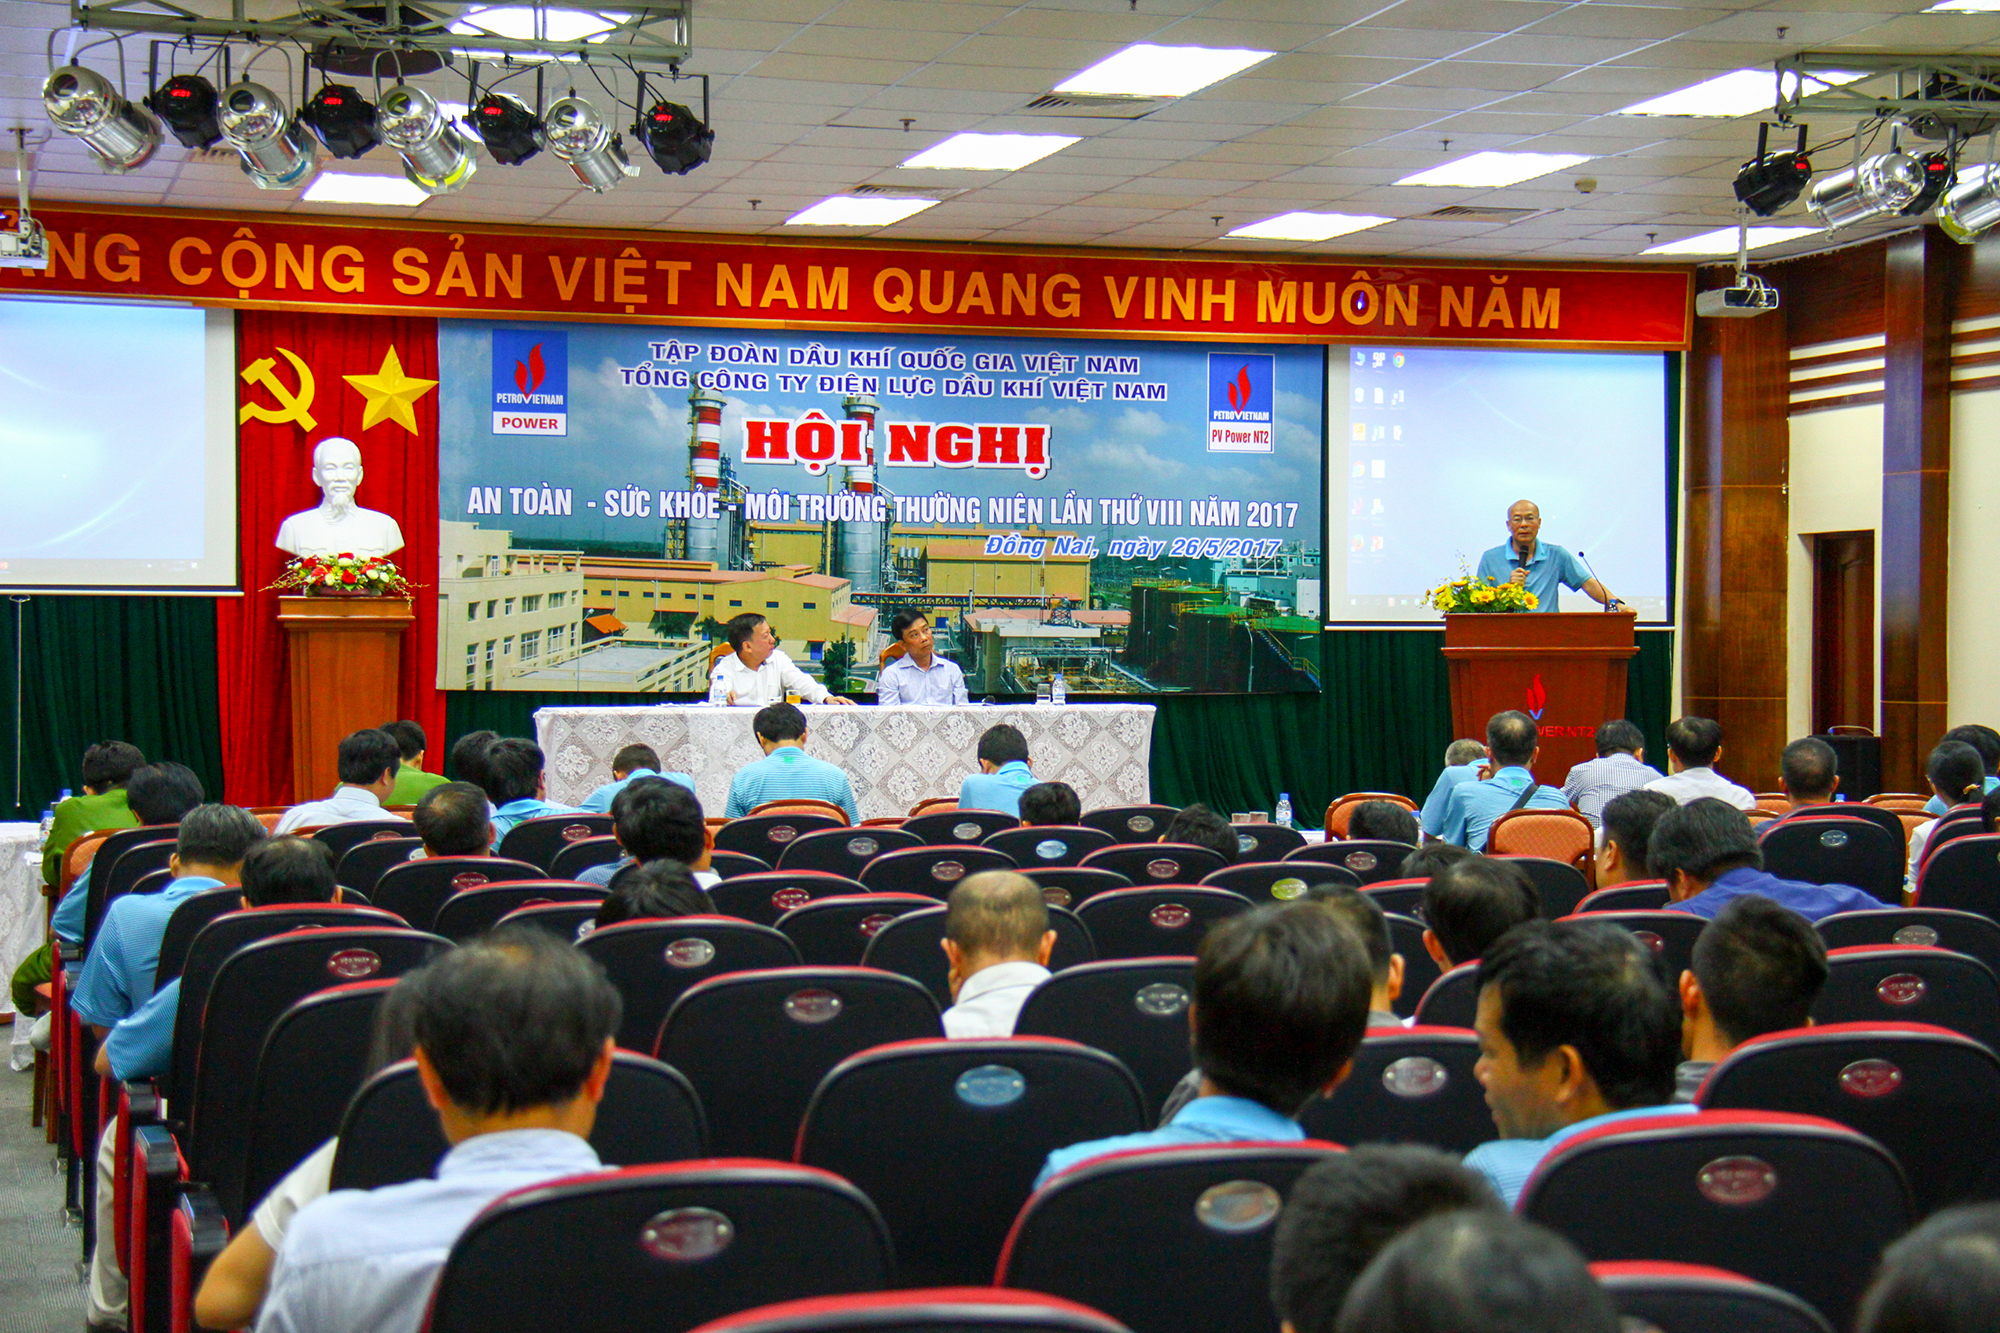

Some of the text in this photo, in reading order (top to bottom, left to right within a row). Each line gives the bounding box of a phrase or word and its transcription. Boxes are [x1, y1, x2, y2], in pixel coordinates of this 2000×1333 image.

[168, 227, 366, 299] CỘNG
[392, 233, 523, 299] SẢN
[548, 247, 692, 313] VIỆT
[715, 262, 849, 310] NAM
[873, 267, 1081, 318] QUANG
[1104, 275, 1236, 323] VINH
[1257, 270, 1419, 327] MUÔN
[1439, 275, 1561, 329] NĂM
[650, 340, 1140, 375] TẬP ĐOÀN DẦU KHÍ QUỐC GIA VIỆT NAM
[621, 363, 1167, 402] TỔNG CÔNG TY ĐIỆN LỰC DẦU KHÍ VIỆT NAM
[496, 392, 564, 405] PETROVIETNAM
[502, 417, 558, 430] POWER
[1213, 410, 1270, 421] PETROVIETNAM
[743, 410, 1051, 480] HỘI NGHỊ
[1212, 429, 1269, 444] PV Power NT2
[467, 487, 502, 515] AN
[509, 481, 572, 516] TOÀN
[604, 484, 650, 518] SỨC
[659, 483, 720, 519] KHỎE
[745, 488, 790, 521] MÔI
[797, 489, 886, 523] TRƯỜNG
[893, 491, 981, 524] THƯỜNG
[988, 492, 1043, 524] NIÊN
[1050, 489, 1092, 525] LẦN
[1099, 492, 1144, 526] THỨ
[1146, 499, 1183, 526] VIII
[1190, 495, 1240, 527] NĂM
[1246, 502, 1299, 528] 2017
[985, 532, 1281, 560] Đồng Nai, ngày 26/5/2017
[1567, 725, 1595, 738] NT2
